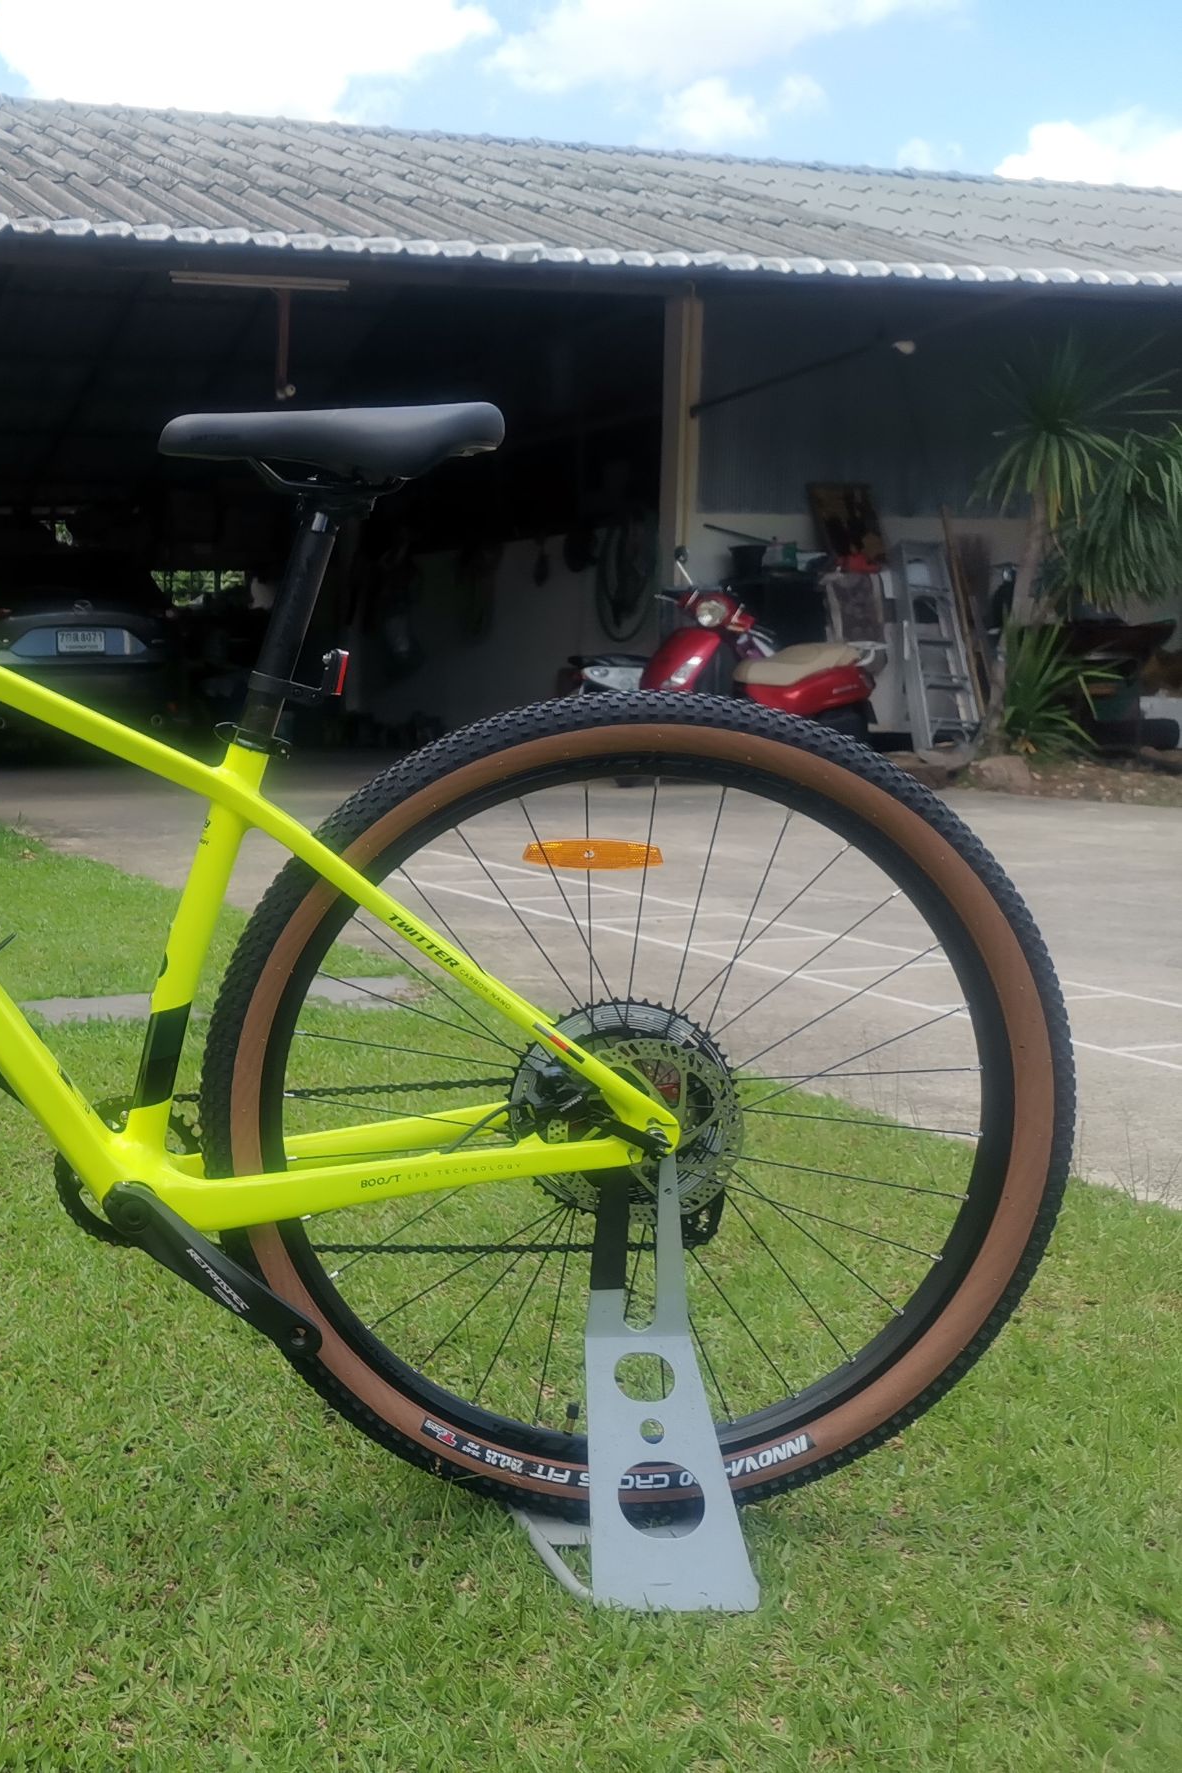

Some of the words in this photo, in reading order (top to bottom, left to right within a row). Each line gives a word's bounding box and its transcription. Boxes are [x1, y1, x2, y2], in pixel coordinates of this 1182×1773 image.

[387, 912, 460, 969] TWITTER
[490, 991, 513, 1011] NANO
[360, 1173, 403, 1189] BOOST
[436, 1162, 523, 1177] TECHNOLOGY
[186, 1249, 250, 1310] RETROSPEC
[484, 1448, 524, 1474] 29x2.25
[528, 1464, 571, 1484] FIT
